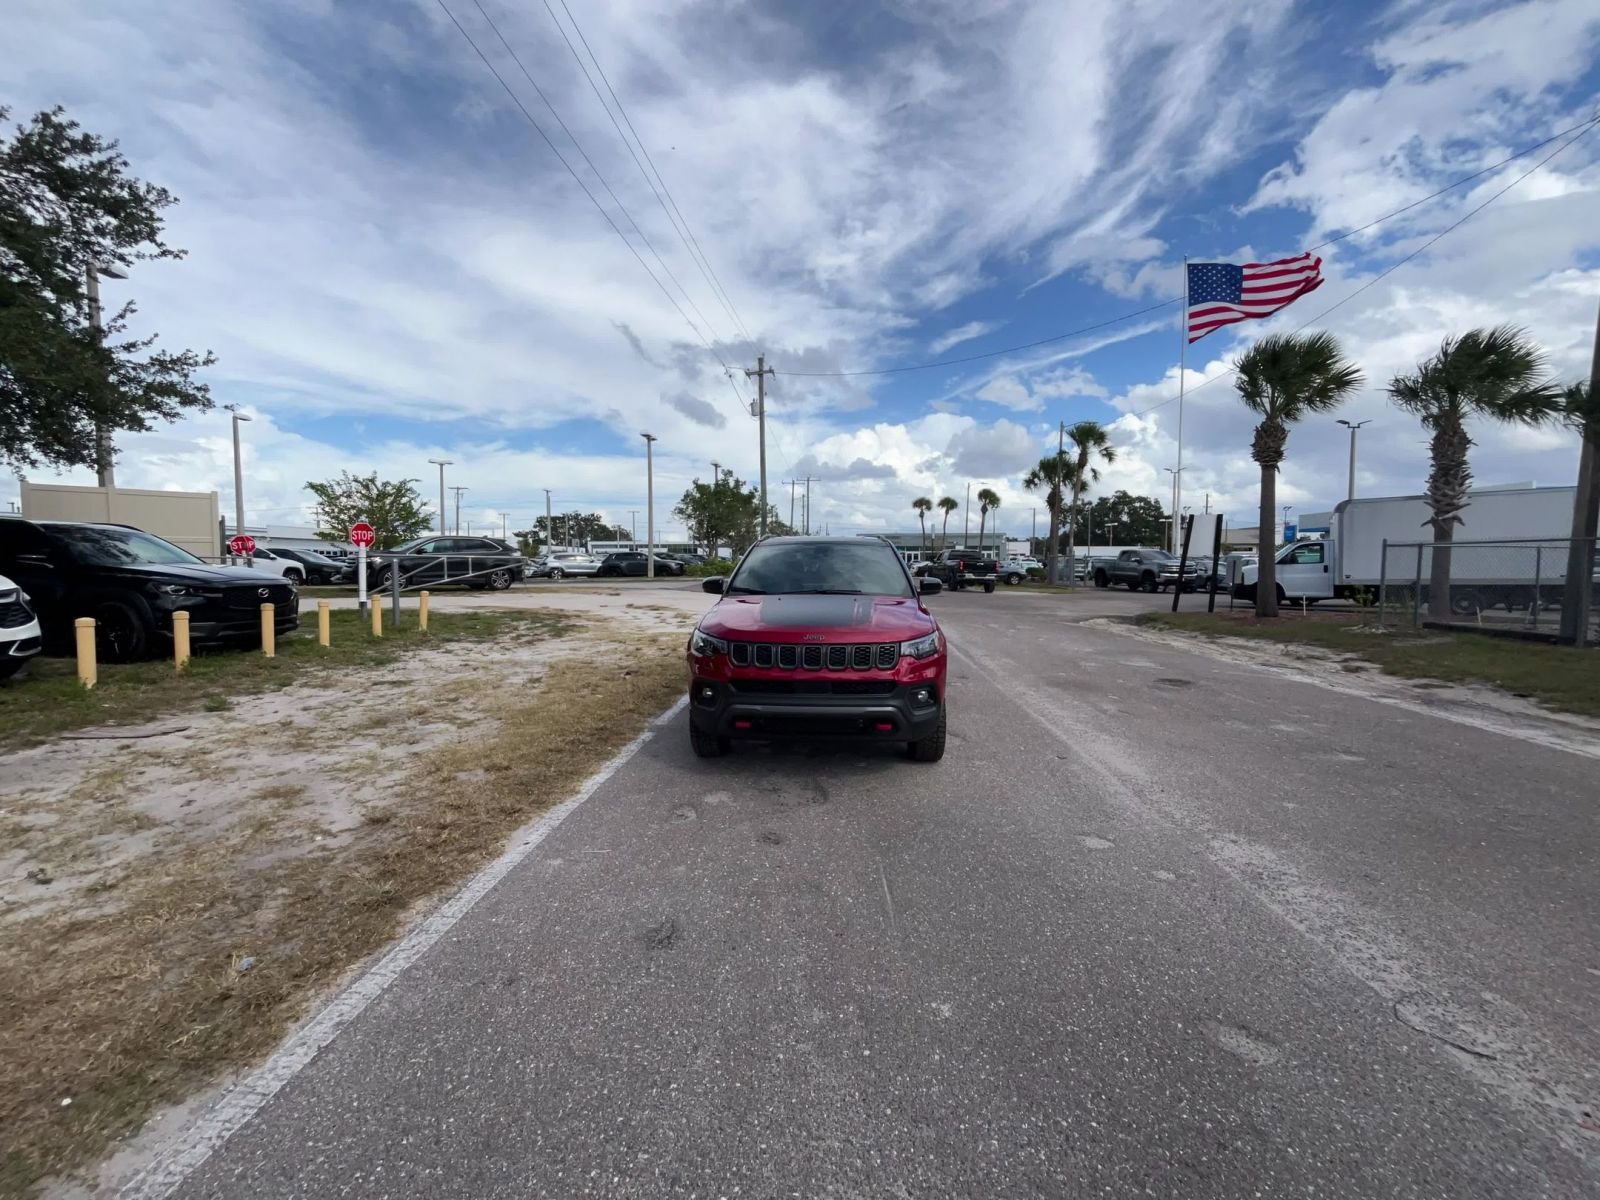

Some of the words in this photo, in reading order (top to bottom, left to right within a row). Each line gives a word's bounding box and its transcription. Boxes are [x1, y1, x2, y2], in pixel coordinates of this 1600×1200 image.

[352, 530, 373, 540] STOP
[232, 541, 254, 550] STP
[803, 633, 825, 641] Jeep
